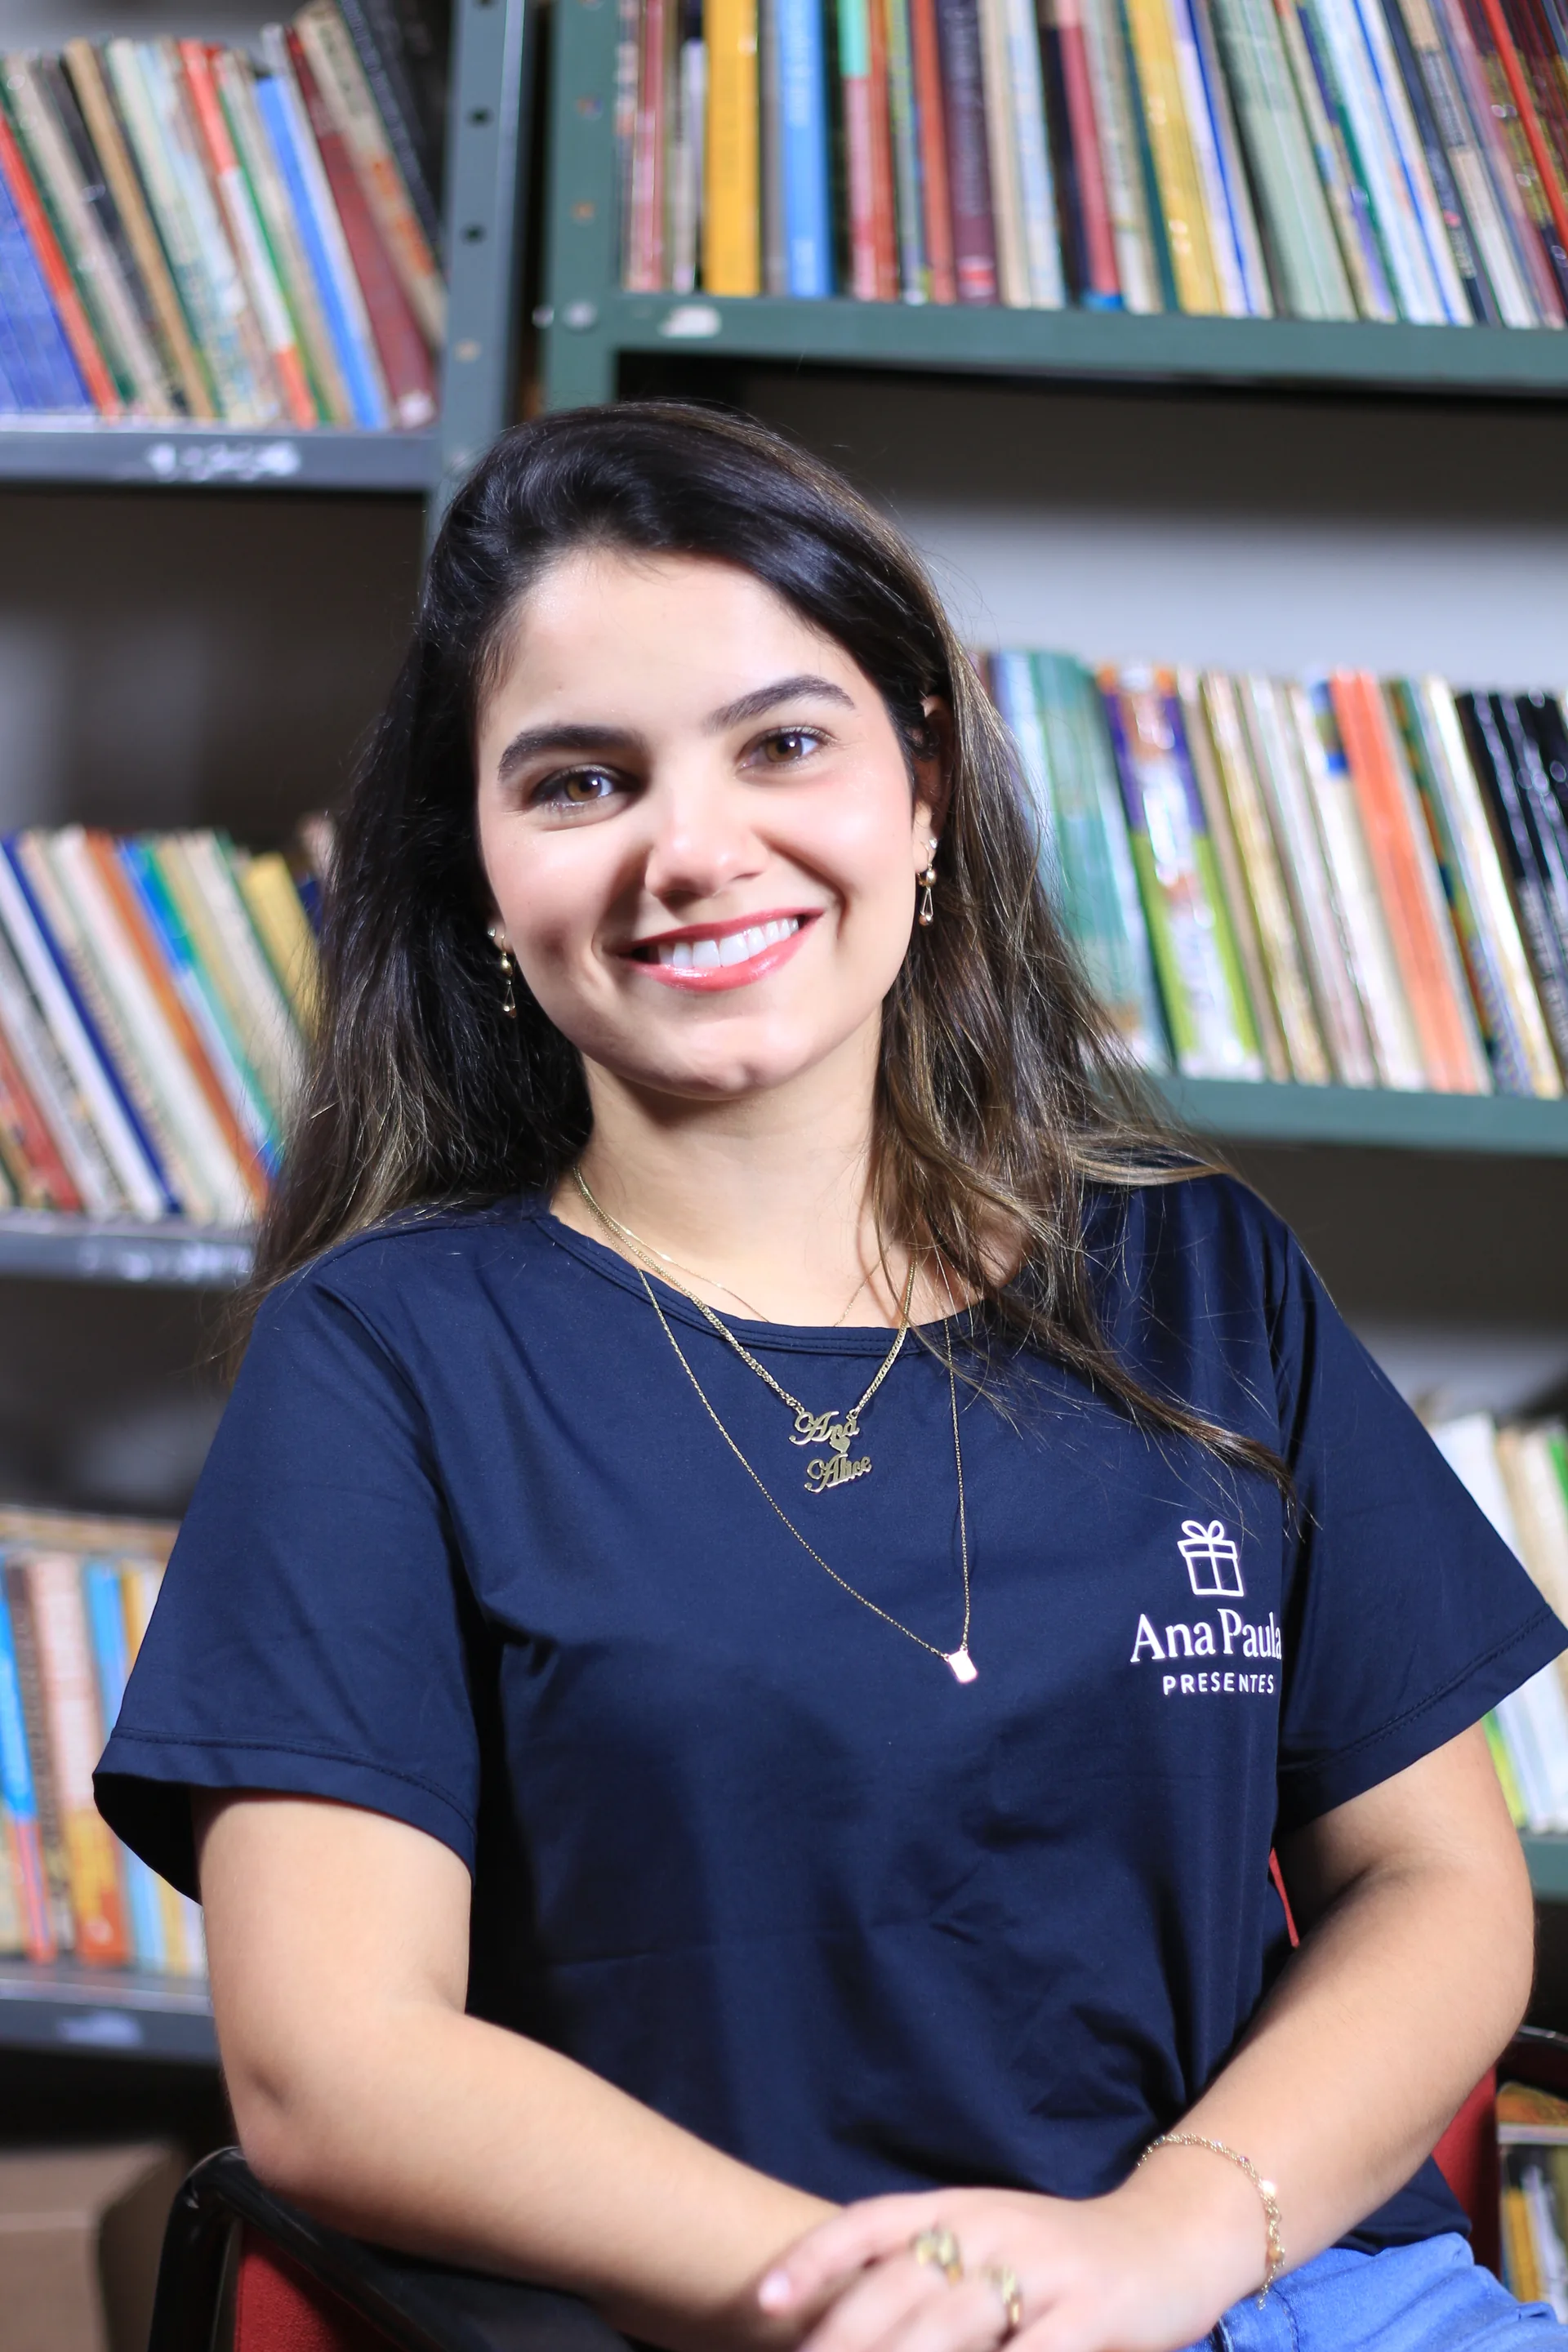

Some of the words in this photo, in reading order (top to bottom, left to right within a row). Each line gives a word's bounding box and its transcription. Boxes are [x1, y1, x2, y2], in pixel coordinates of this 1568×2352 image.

[789, 1410, 860, 1446] Ana
[1129, 1613, 1217, 1664] Ana
[1217, 1608, 1282, 1660] Paula
[1162, 1672, 1275, 1696] PRESENTES
